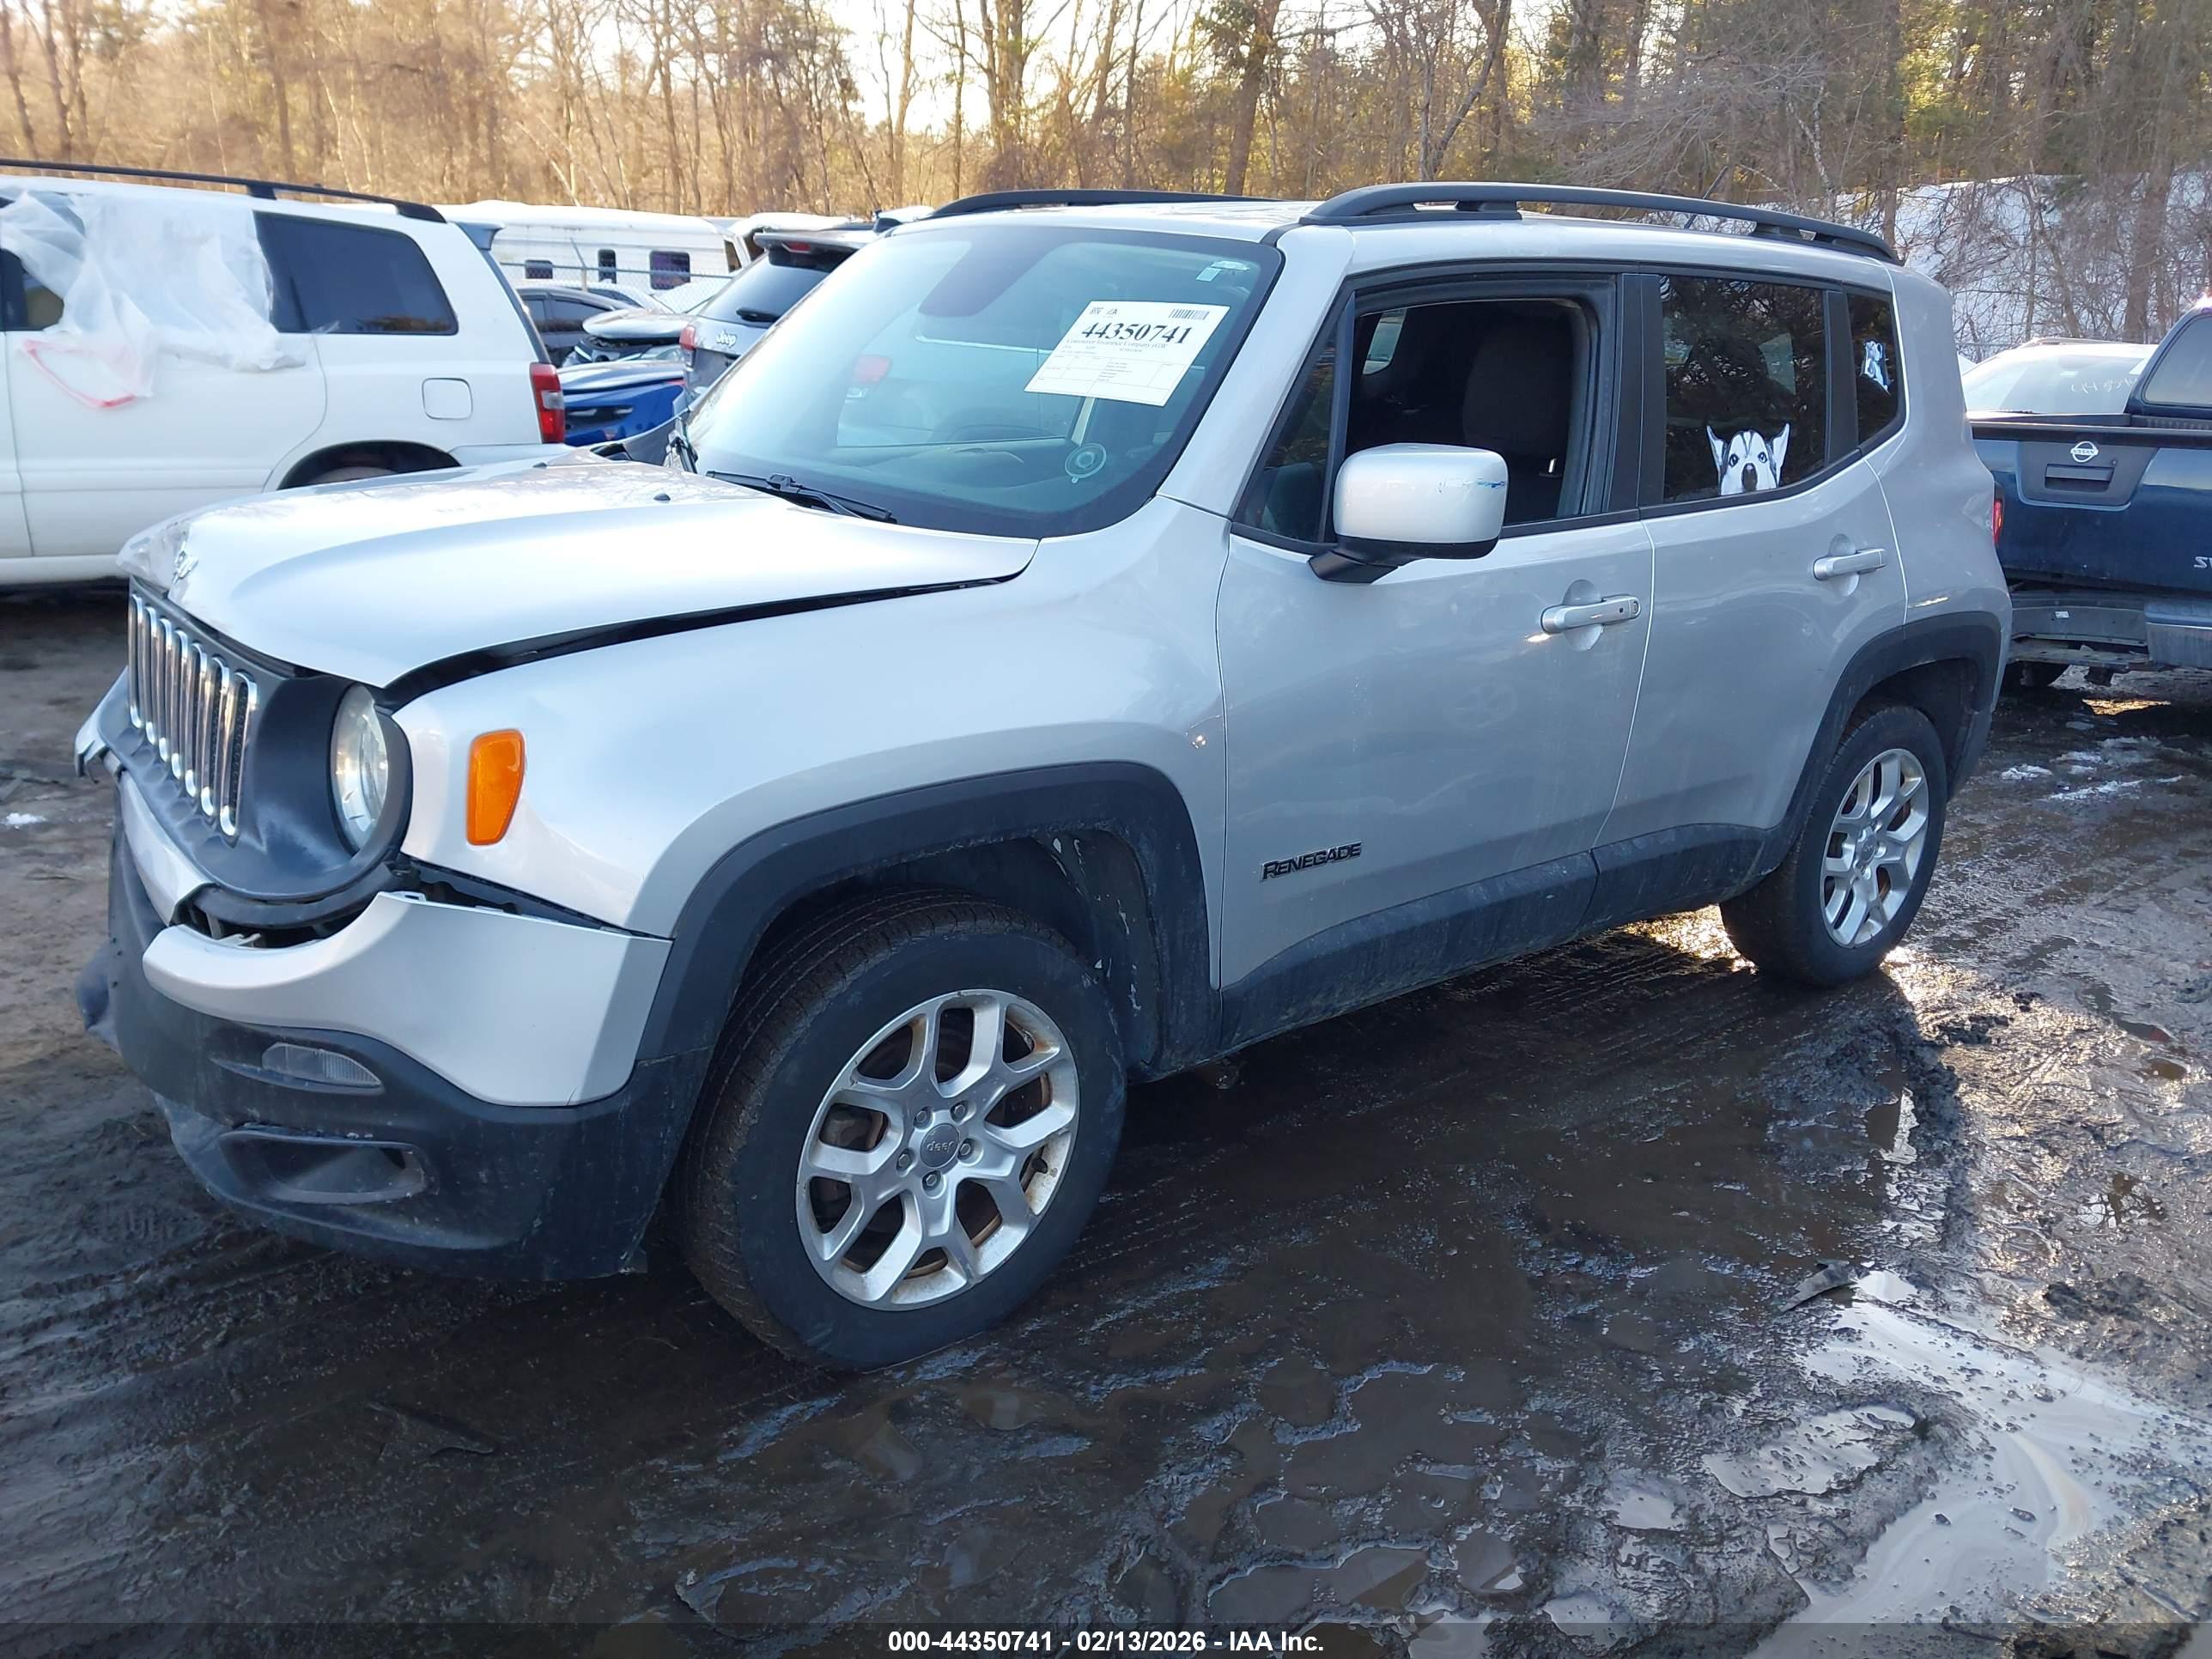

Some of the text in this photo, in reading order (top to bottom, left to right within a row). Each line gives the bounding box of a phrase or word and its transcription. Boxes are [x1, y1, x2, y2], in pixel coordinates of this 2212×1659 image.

[715, 331, 737, 348] Jeep
[1082, 322, 1192, 344] 44350741
[1261, 842, 1363, 880] RENEGADE
